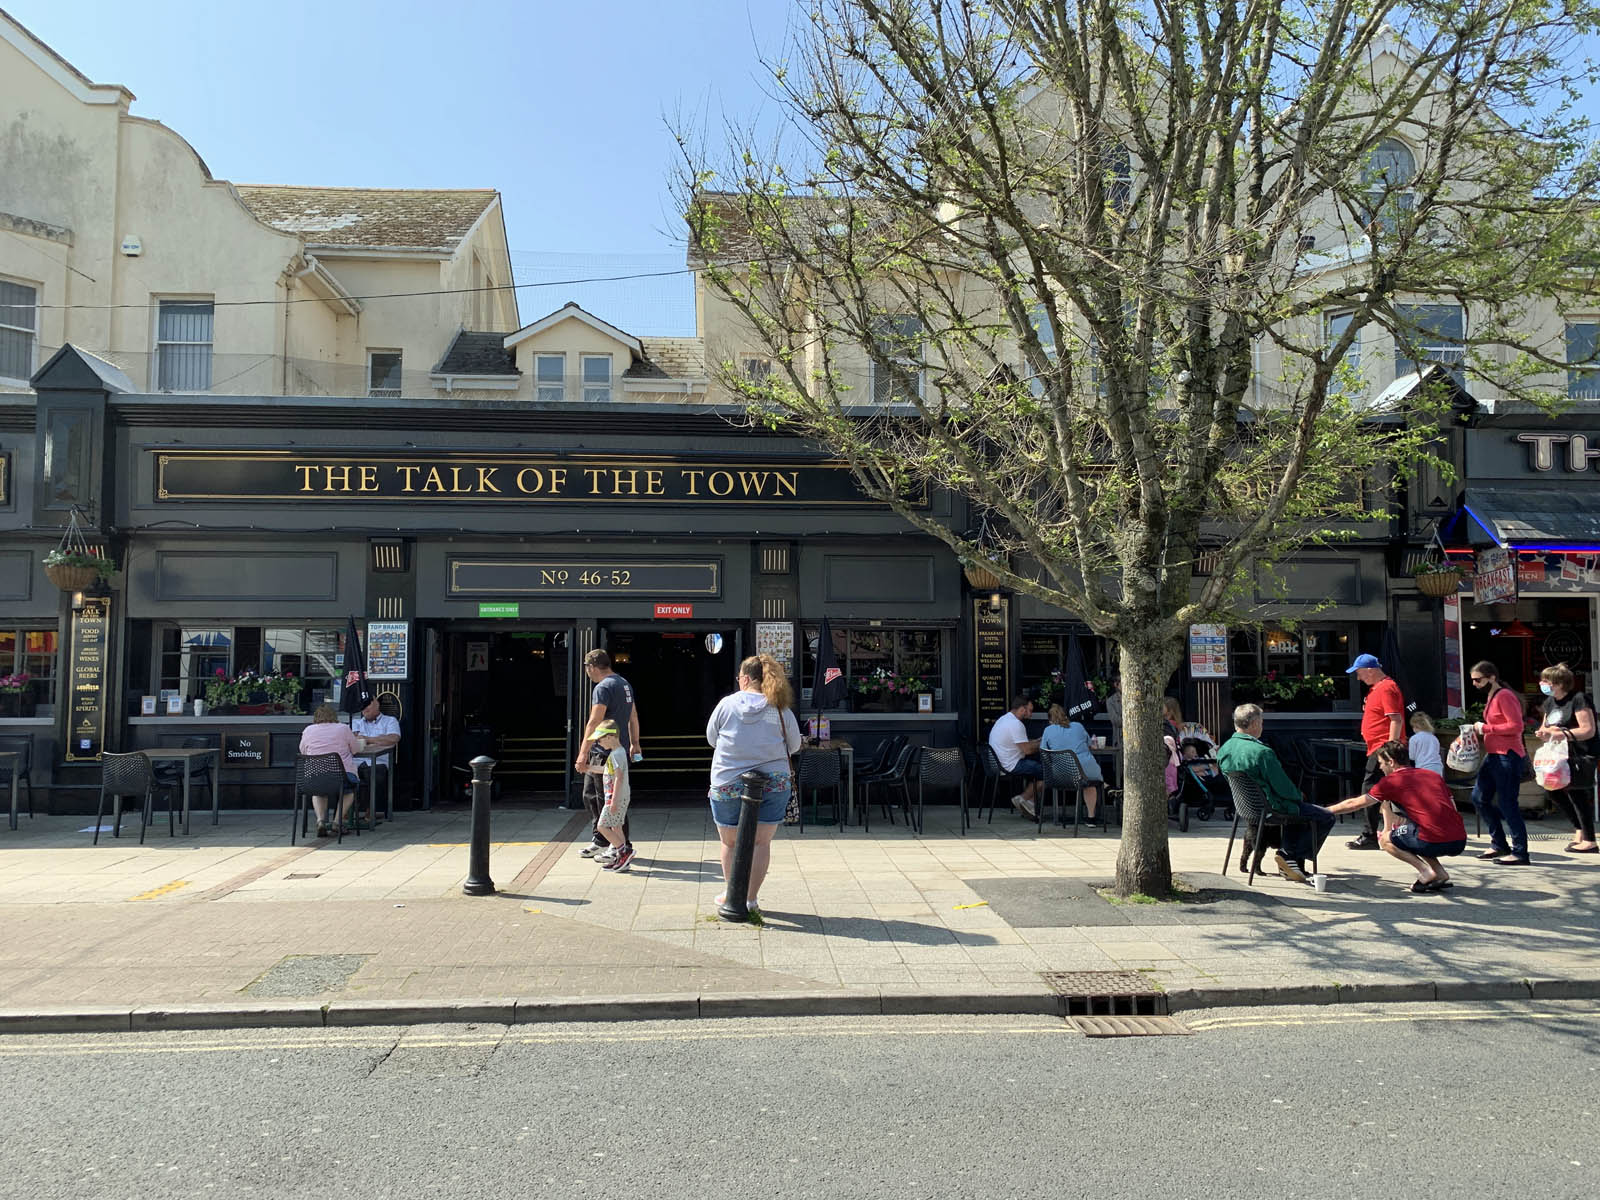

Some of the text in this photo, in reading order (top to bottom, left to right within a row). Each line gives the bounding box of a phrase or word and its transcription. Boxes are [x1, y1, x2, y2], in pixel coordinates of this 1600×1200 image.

[295, 465, 799, 497] THE TALK OF THE TOWN
[579, 570, 631, 586] 46-52
[657, 606, 690, 614] EXIT ONLY
[240, 739, 251, 747] No
[228, 750, 262, 760] Smoking
